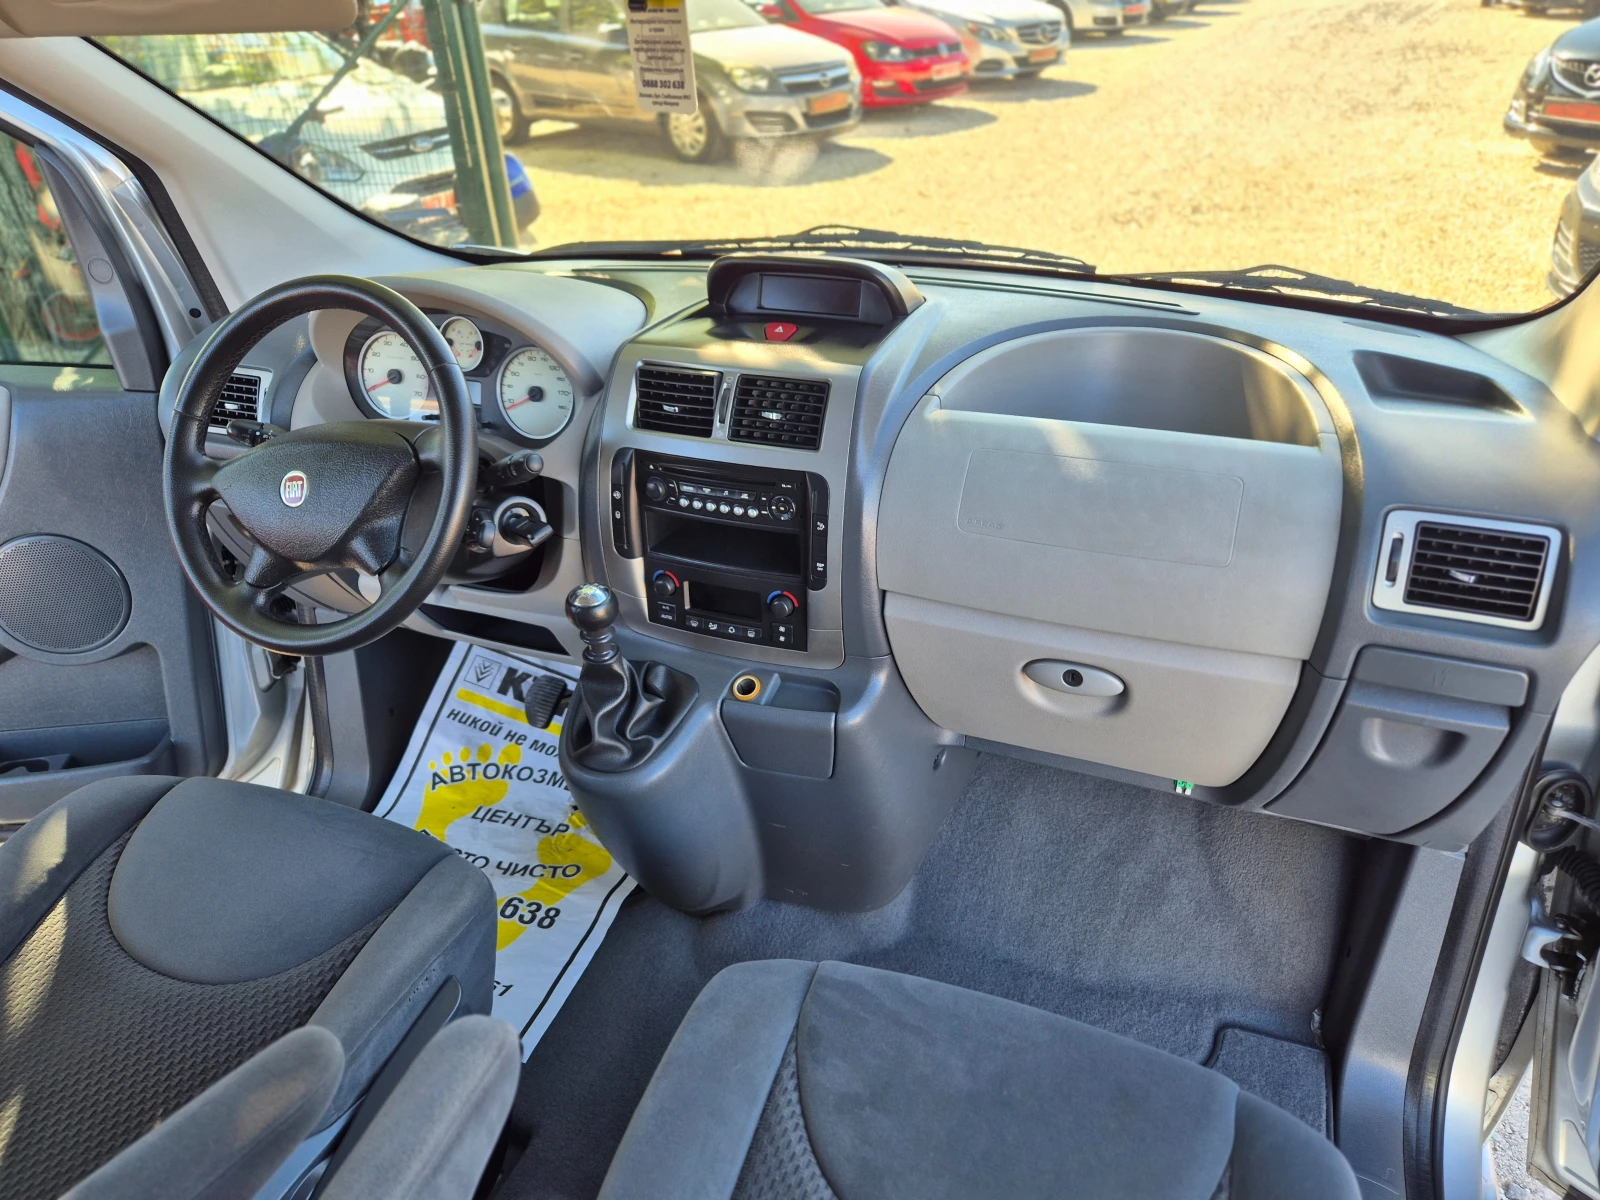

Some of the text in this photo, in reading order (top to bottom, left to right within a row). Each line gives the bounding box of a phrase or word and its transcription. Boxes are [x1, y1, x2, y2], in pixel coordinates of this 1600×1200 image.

[642, 79, 685, 90] 0888 302 638
[286, 481, 303, 498] FIAT
[965, 519, 1002, 529] AIRBAG
[447, 709, 559, 758] никой не мо
[431, 762, 571, 792] АВТОКОЗМ
[471, 806, 571, 837] ЦЕНТЪР
[495, 861, 582, 879] ЧИСТО
[500, 896, 561, 930] 638
